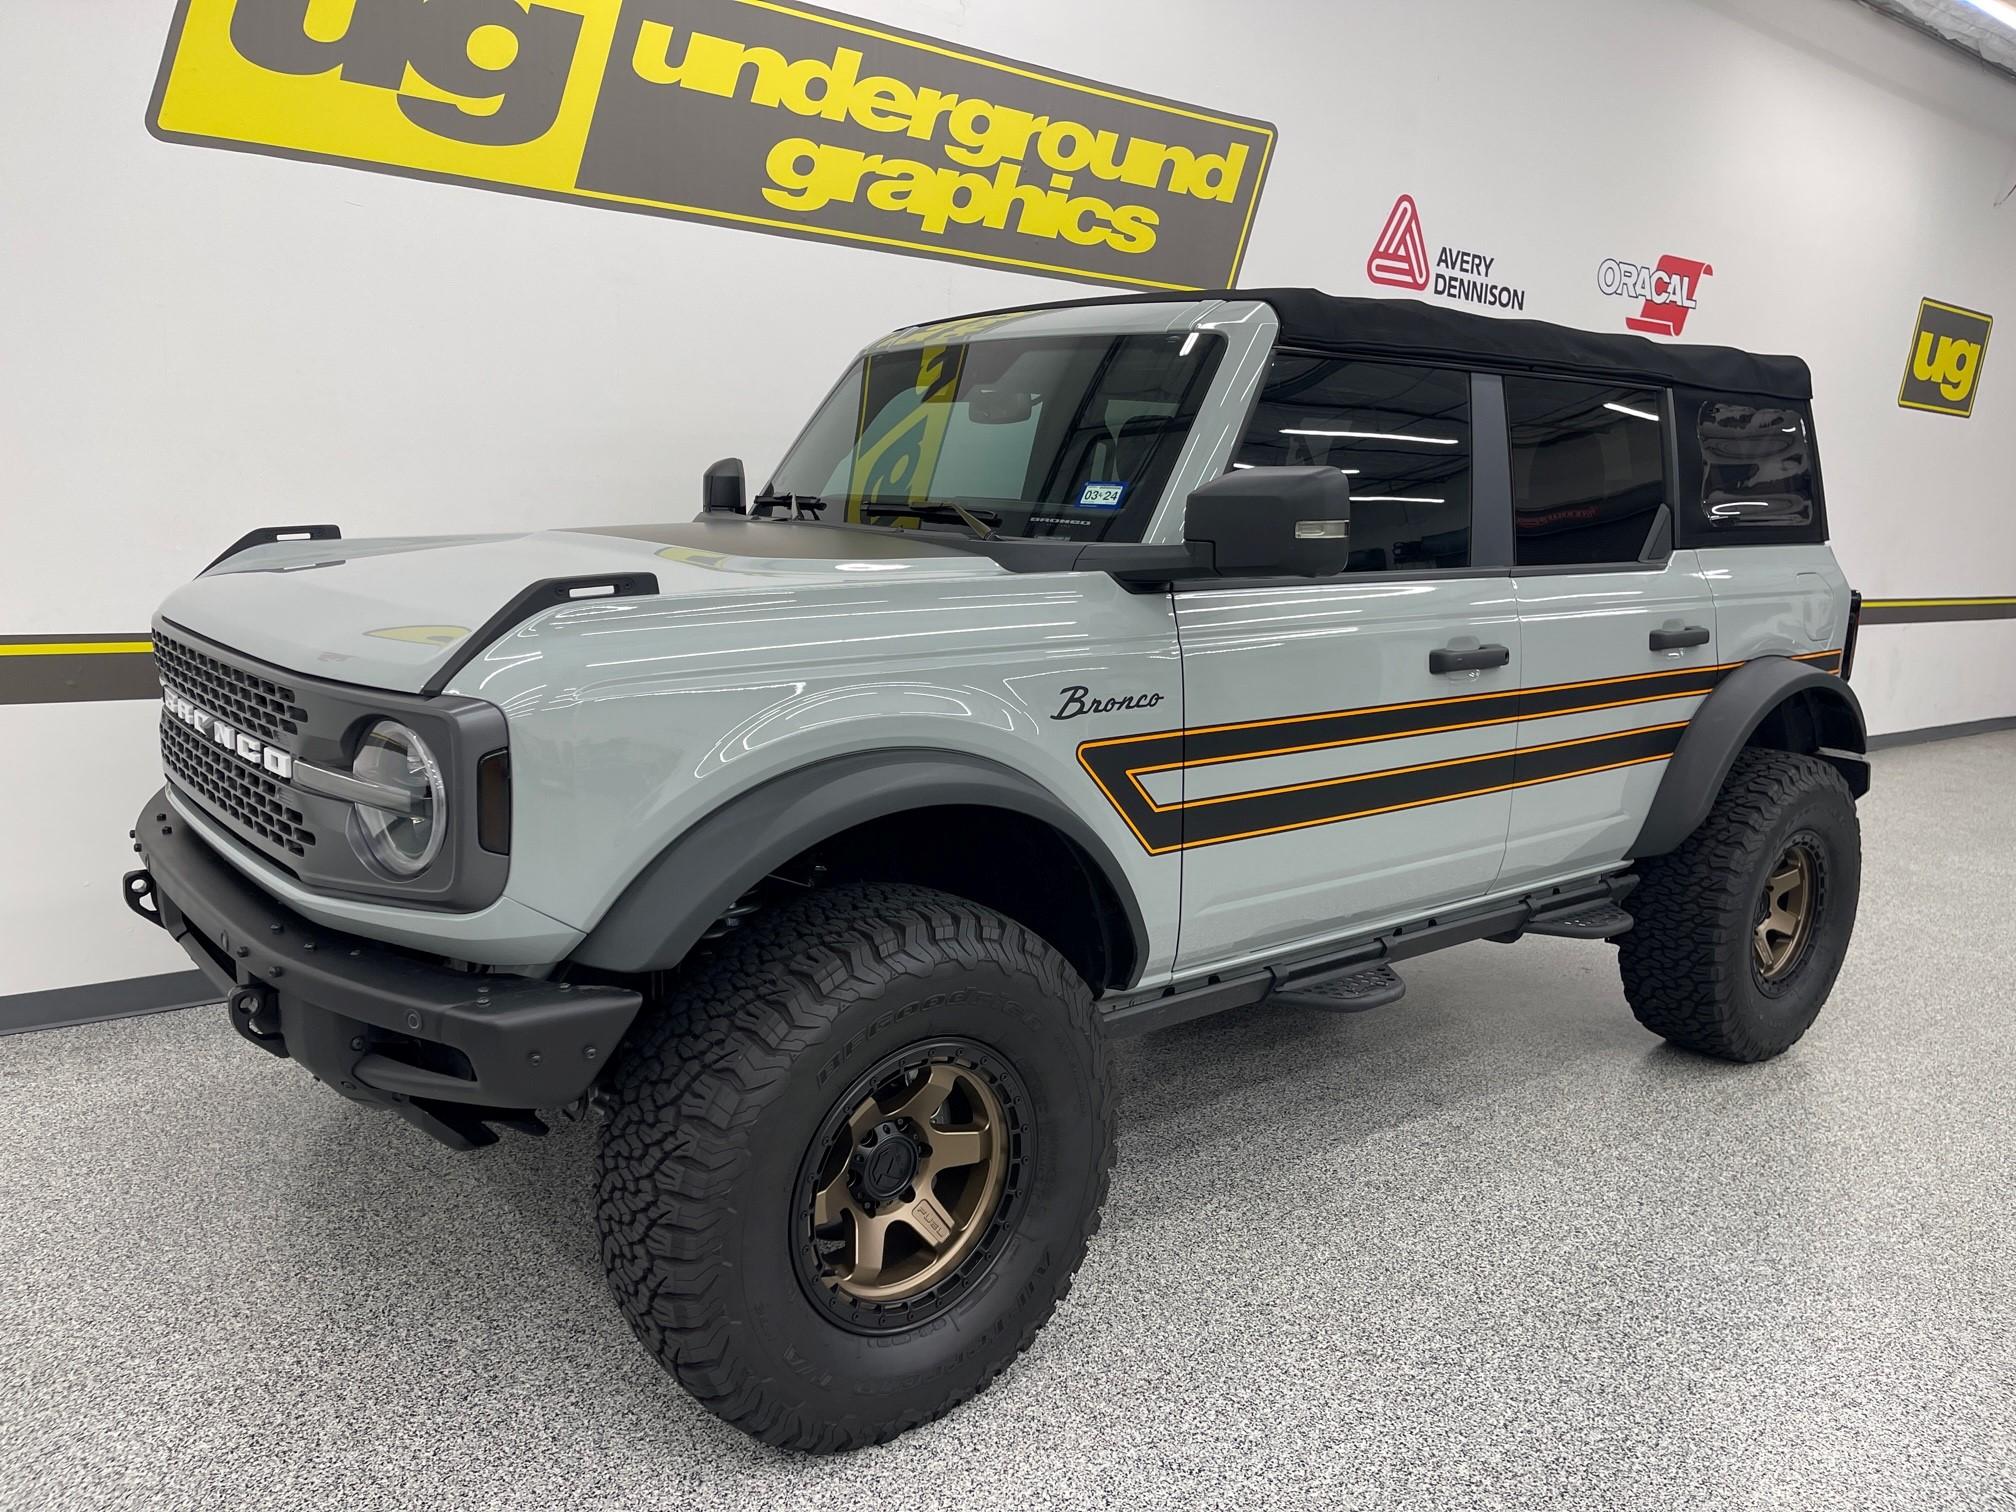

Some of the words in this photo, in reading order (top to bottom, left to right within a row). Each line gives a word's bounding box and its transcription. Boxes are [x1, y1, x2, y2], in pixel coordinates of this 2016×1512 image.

[632, 19, 1250, 204] underground
[761, 137, 1160, 254] graphics
[1436, 246, 1495, 278] AVERY
[1597, 257, 1697, 310] ORACAL
[1433, 272, 1526, 311] DENNISON
[1913, 330, 1981, 402] ug
[1050, 685, 1165, 721] Bronco
